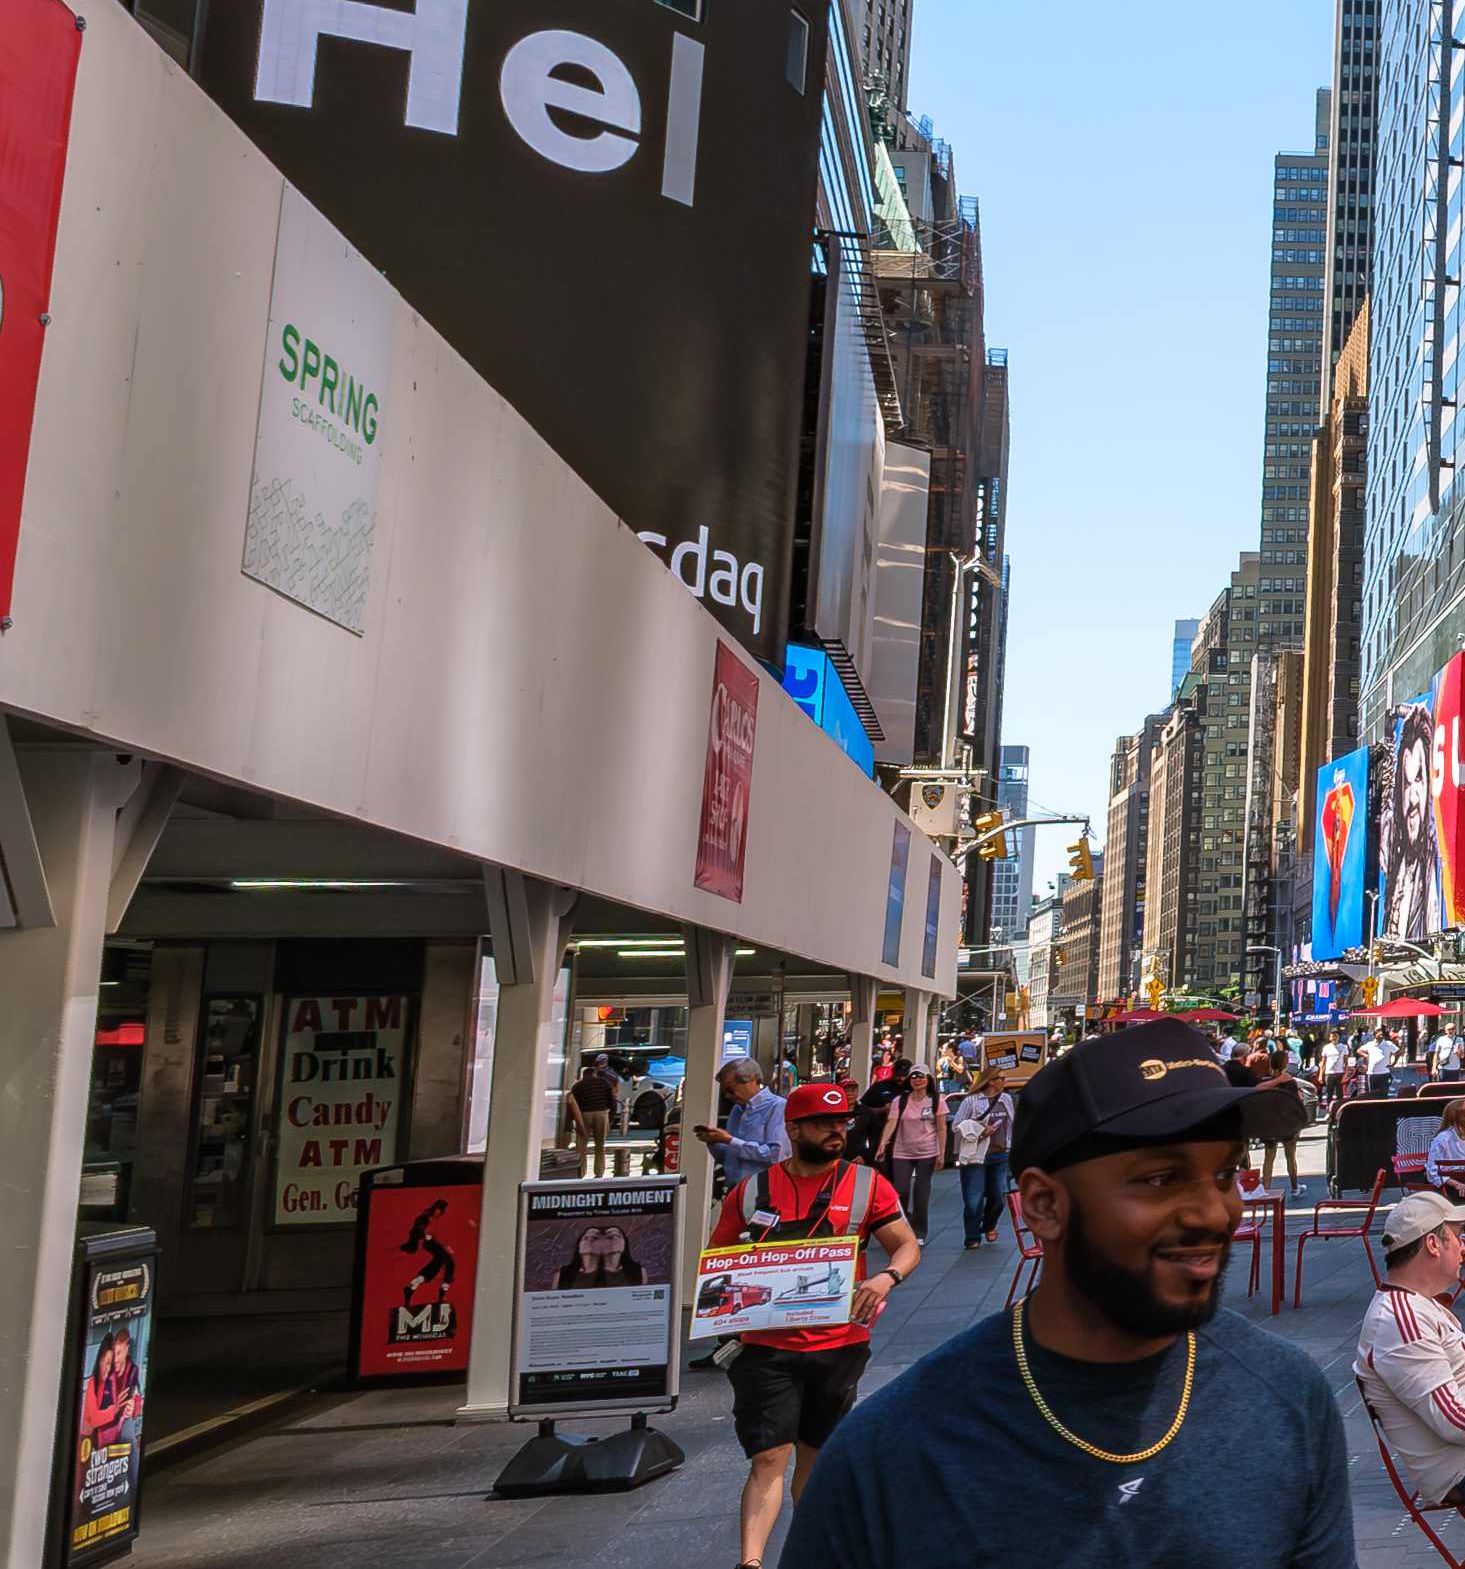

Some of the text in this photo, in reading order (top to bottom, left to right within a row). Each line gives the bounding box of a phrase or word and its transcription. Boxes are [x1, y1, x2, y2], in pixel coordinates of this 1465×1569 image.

[279, 325, 379, 445] SPRING
[291, 396, 364, 466] SCAFFOLDING
[293, 997, 399, 1032] ATM
[291, 1047, 397, 1083] Drink
[287, 1093, 392, 1130] Candy
[299, 1138, 382, 1167] ATM
[283, 1182, 327, 1213] Gen.
[532, 1189, 673, 1209] MIDNIGHT MOMENT
[705, 1247, 852, 1270] Hop-On Hop-Off Pass
[397, 1303, 451, 1335] MJ
[85, 1455, 128, 1488] strangers
[90, 1447, 107, 1470] two
